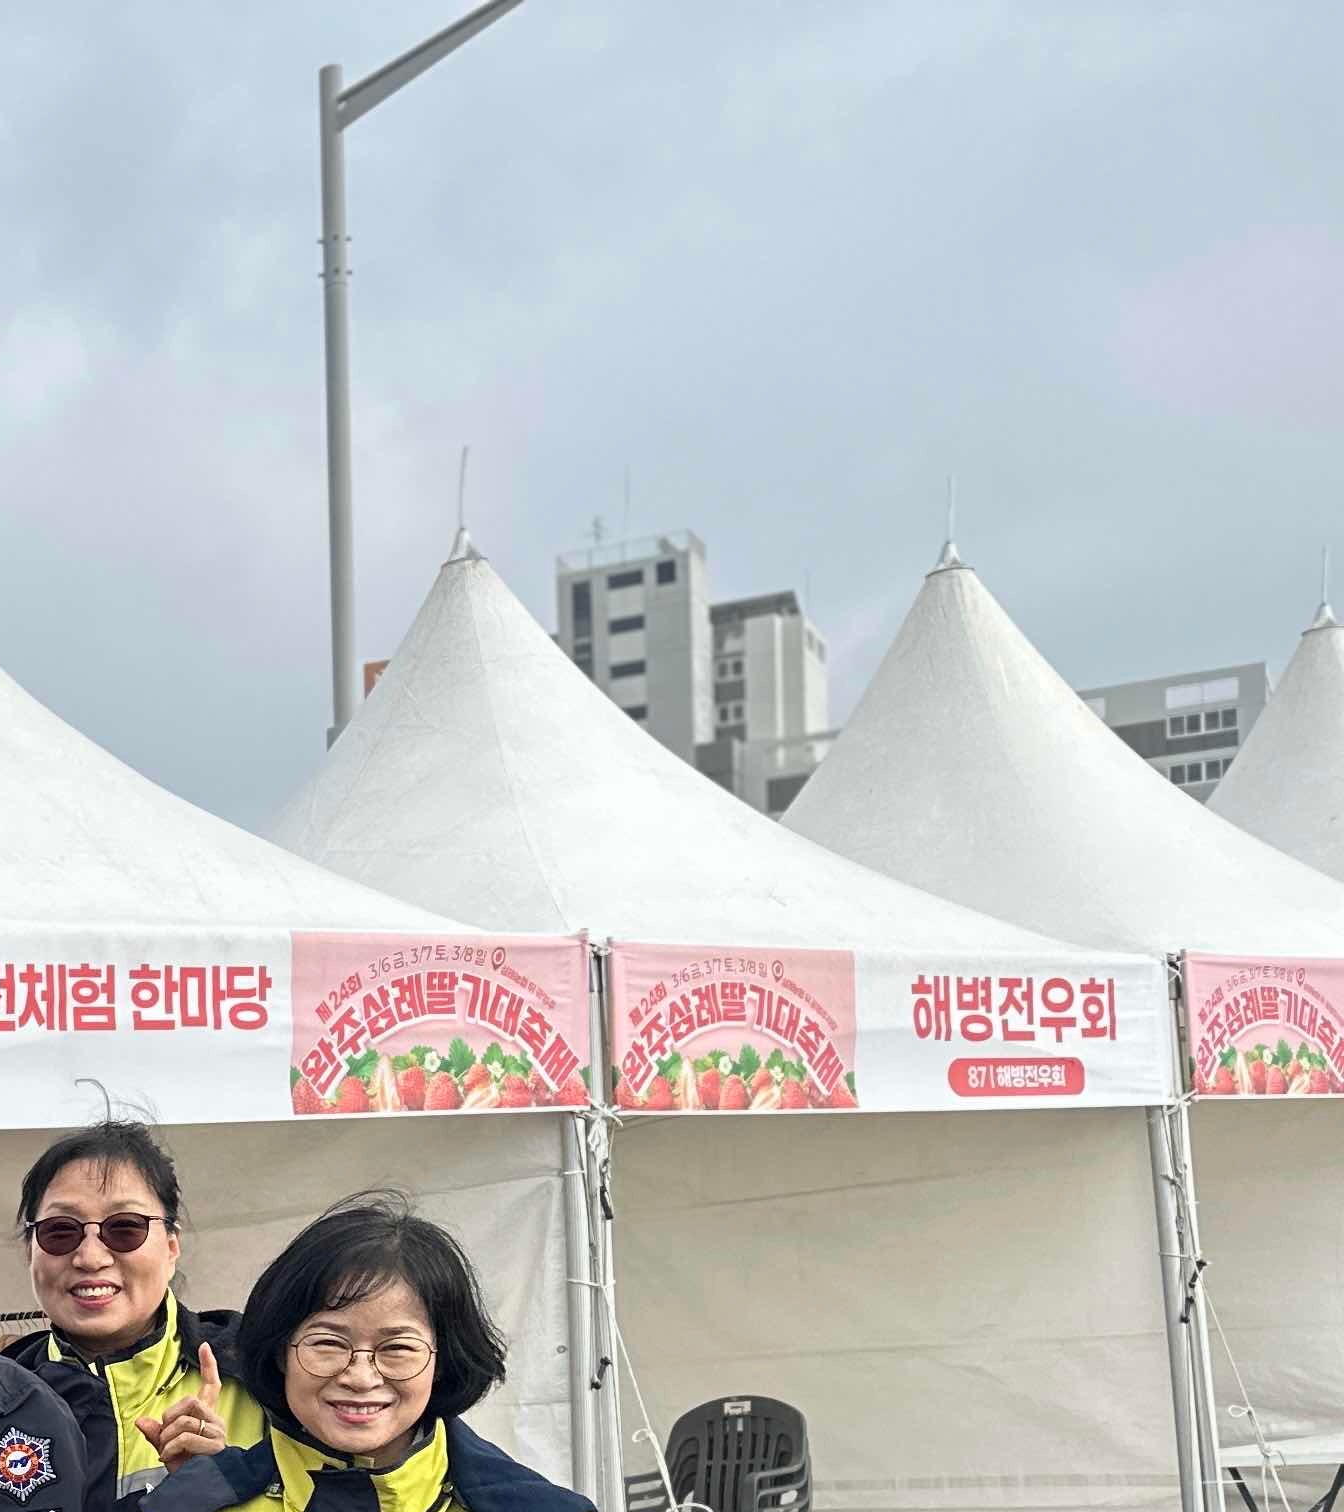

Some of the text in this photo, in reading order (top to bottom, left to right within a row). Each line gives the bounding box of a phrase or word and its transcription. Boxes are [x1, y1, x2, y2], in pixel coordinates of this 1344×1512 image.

[129, 963, 273, 1031] 한마당
[912, 974, 1116, 1042] 해병전우회
[301, 971, 580, 1097] 완주삼례딸기대축제
[622, 982, 844, 1095] 완주삼례딸기대축제
[967, 1064, 1067, 1088] 87 해병전우회
